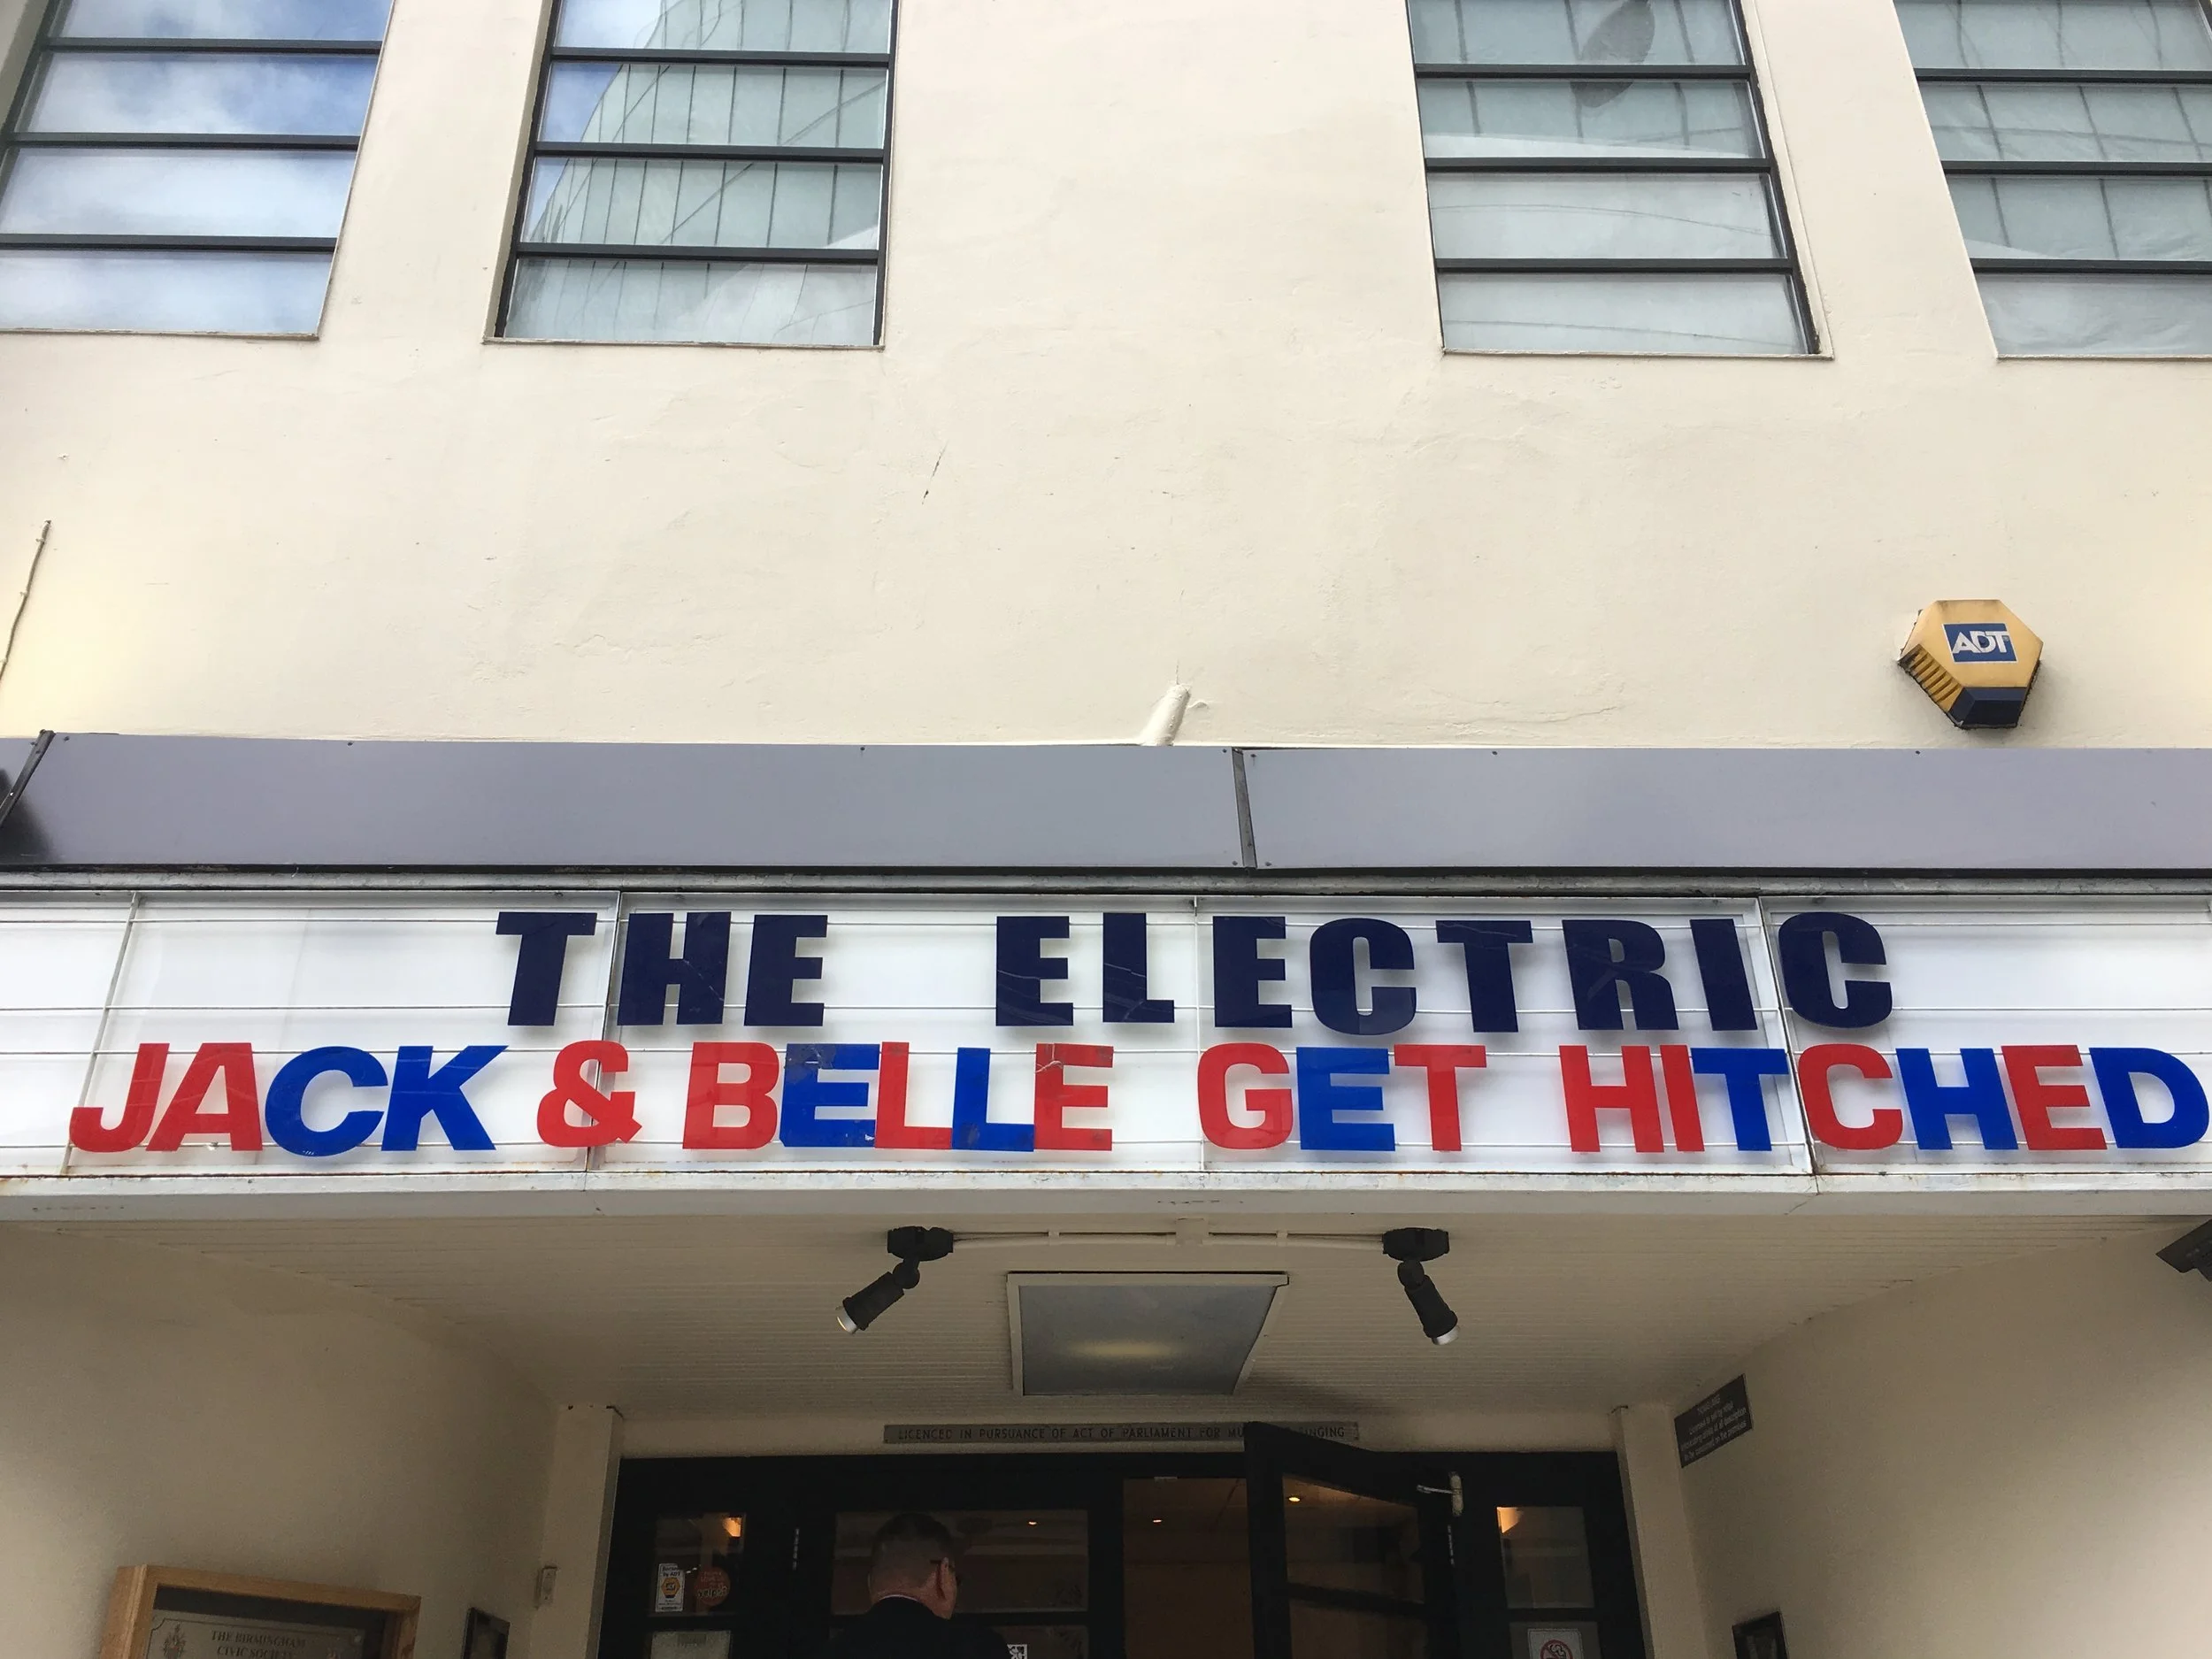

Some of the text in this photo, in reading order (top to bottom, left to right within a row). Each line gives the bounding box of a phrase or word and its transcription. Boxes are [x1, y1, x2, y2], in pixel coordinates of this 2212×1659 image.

[1952, 630, 2009, 654] ADT
[496, 911, 1893, 1035] THE ELECTRIC
[69, 1040, 2209, 1156] JACK & BELLE GET HITCHED
[898, 1428, 953, 1440] LICENCED
[960, 1428, 972, 1440] IN
[979, 1428, 1045, 1440] PURSUANCE
[1051, 1428, 1066, 1439] OF
[1072, 1427, 1094, 1439] ACT
[1101, 1427, 1115, 1439] OF
[1122, 1427, 1193, 1439] PARLIAMENT
[1200, 1427, 1220, 1438] FOR
[211, 1630, 306, 1647] THE BIRMINGHAM
[217, 1646, 249, 1657] CIVIC
